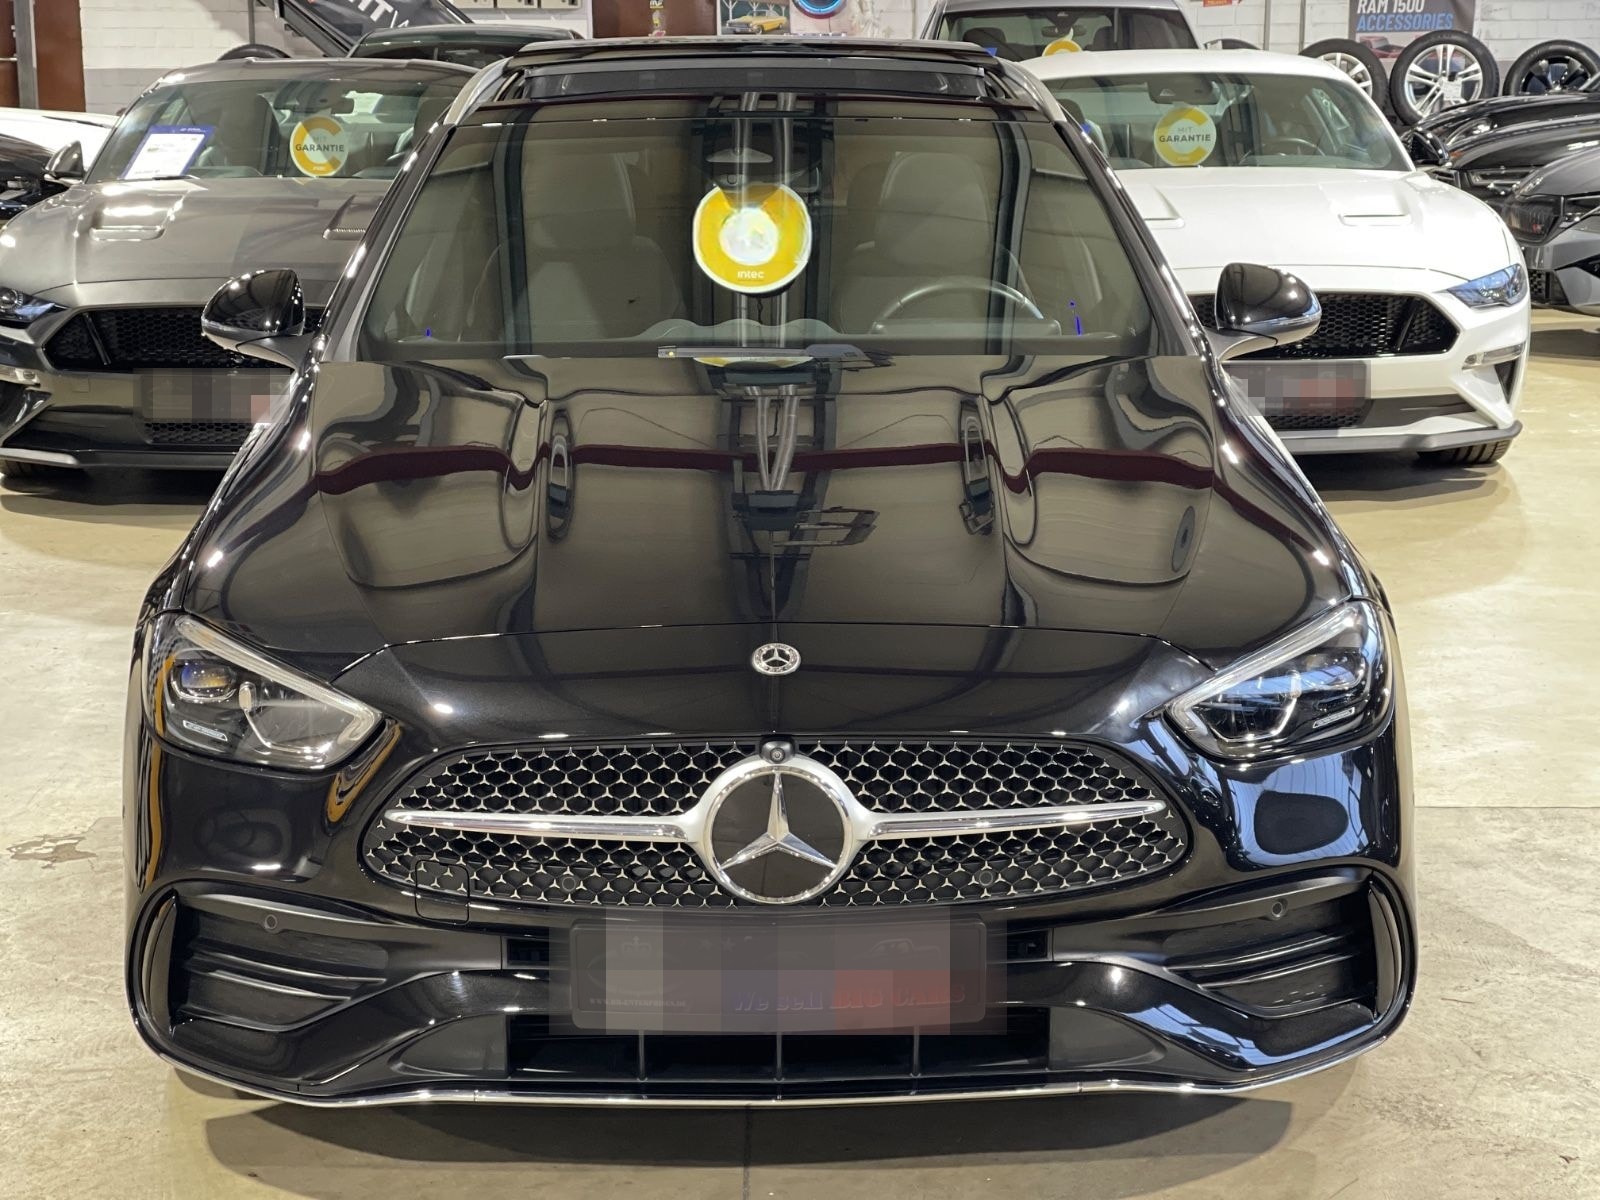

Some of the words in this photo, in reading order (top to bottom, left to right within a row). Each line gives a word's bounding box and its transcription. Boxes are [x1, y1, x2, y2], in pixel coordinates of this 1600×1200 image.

[1357, 0, 1388, 14] RAM
[1393, 0, 1425, 13] 1500
[1356, 13, 1454, 31] ACCESSORIES
[1159, 134, 1211, 143] GARANTIE
[295, 143, 345, 152] GARANTIE
